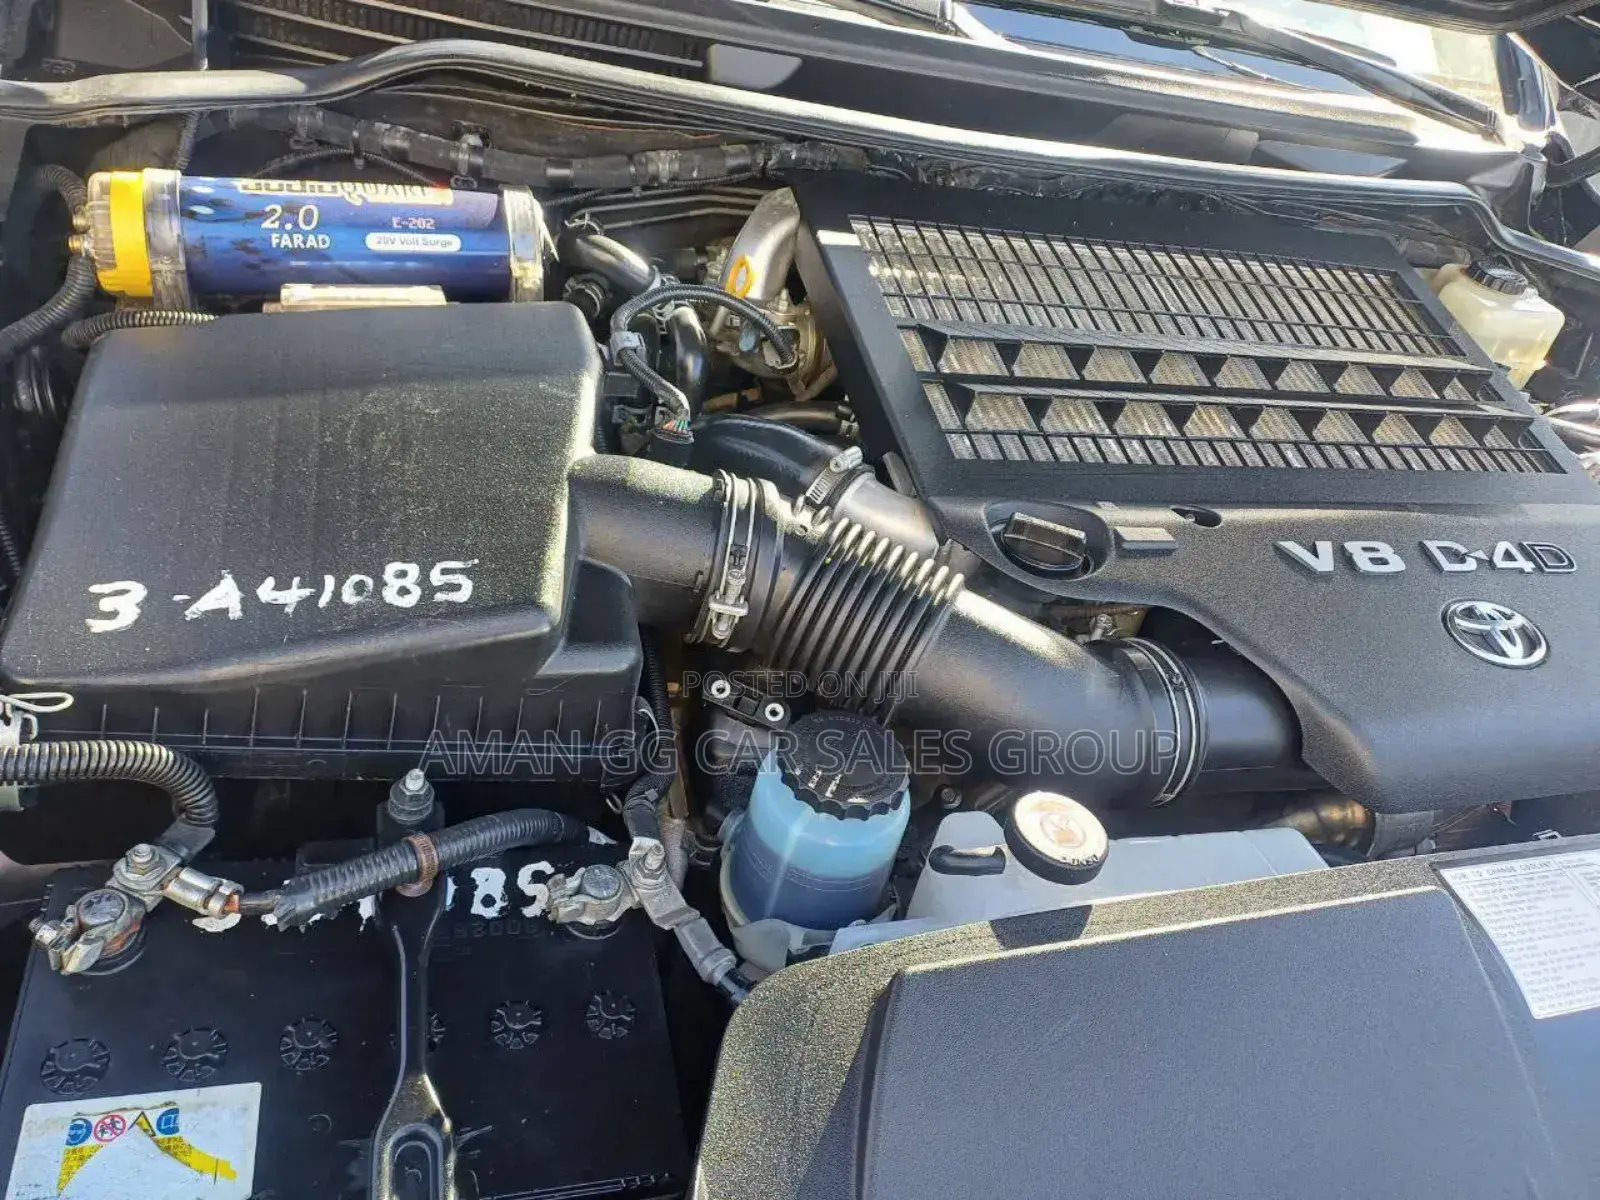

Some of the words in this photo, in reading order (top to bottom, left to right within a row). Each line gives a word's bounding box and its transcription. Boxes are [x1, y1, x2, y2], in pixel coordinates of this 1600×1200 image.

[261, 204, 319, 231] 2.0
[392, 216, 436, 230] E-202
[271, 233, 331, 249] FARAD
[400, 235, 420, 246] Volt
[422, 235, 453, 249] Surge
[1273, 540, 1407, 575] V8
[1418, 540, 1577, 574] D-4D
